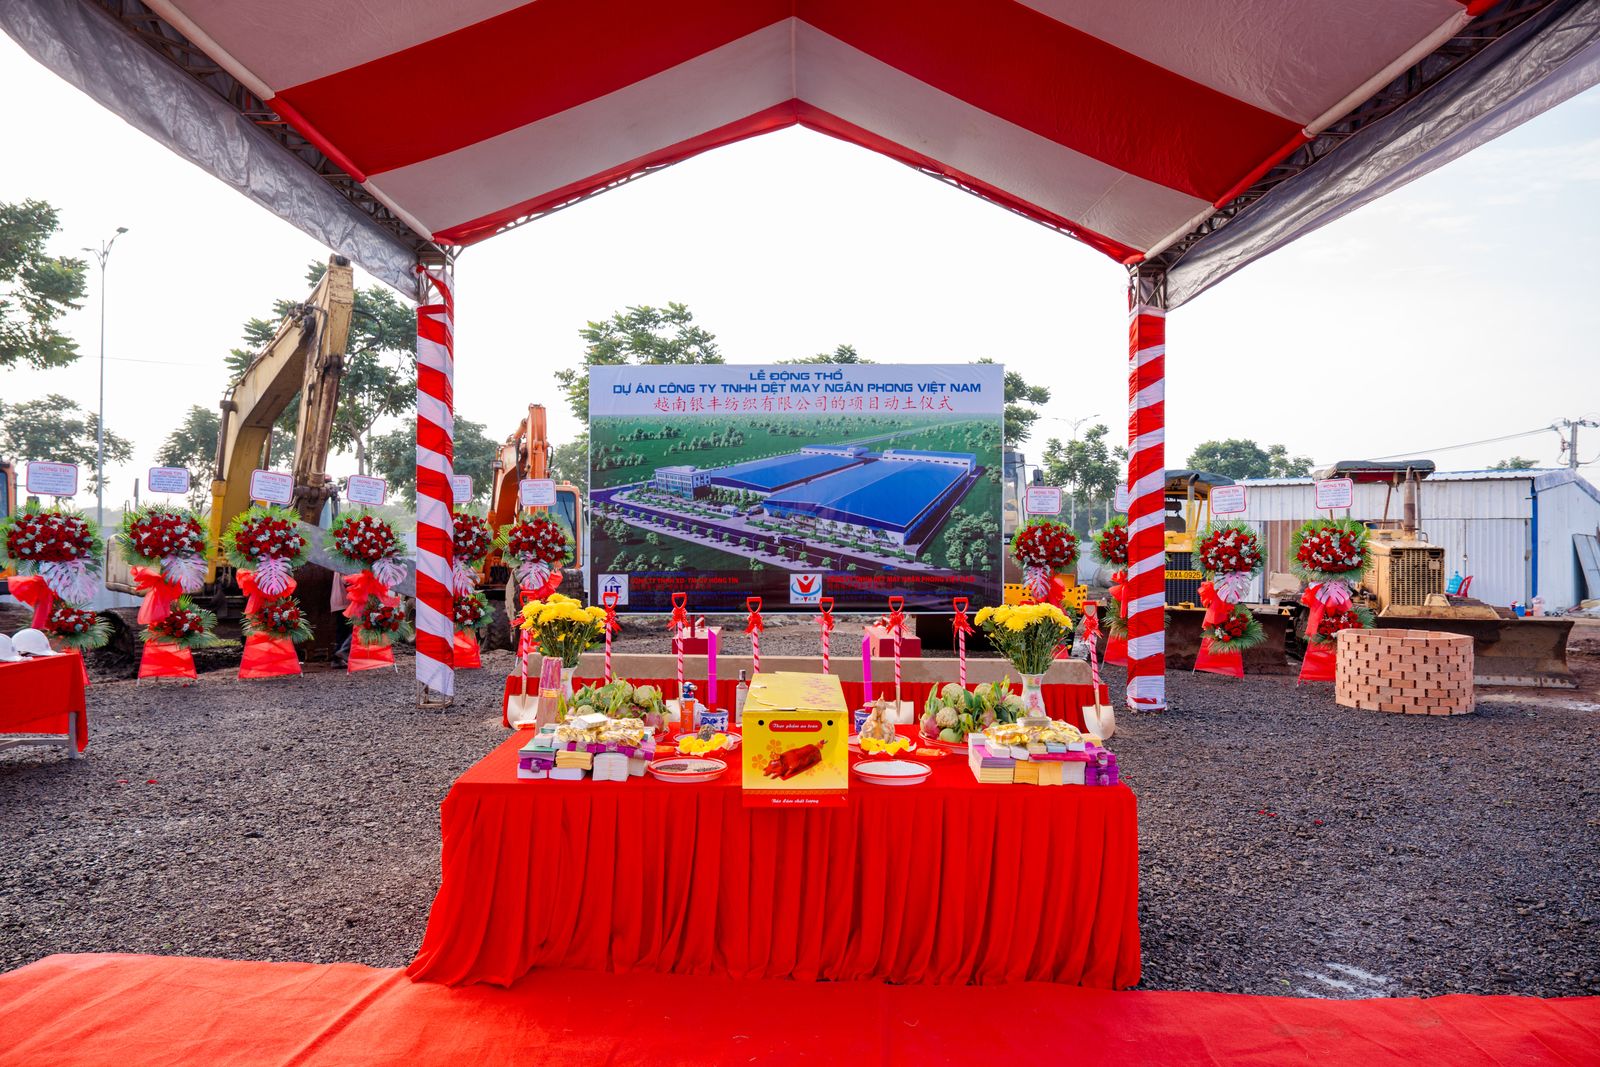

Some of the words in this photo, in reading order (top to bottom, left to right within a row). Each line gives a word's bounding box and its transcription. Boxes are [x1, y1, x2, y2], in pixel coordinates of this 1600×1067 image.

[750, 369, 766, 381] LỄ
[769, 370, 810, 382] ĐỘNG
[814, 369, 843, 380] THỔ
[613, 383, 631, 396] DỰ
[636, 382, 655, 393] ÁN
[659, 382, 695, 393] CÔNG
[699, 384, 716, 393] TY
[721, 384, 757, 393] TNHH
[761, 381, 786, 394] DỆT
[791, 384, 820, 393] MAY
[825, 381, 864, 393] NGÂN
[867, 383, 913, 393] PHONG
[918, 381, 946, 395] VIỆT
[950, 383, 981, 393] NAM
[653, 395, 954, 412] 越南银丰纺织有限公司的项目动土仪式
